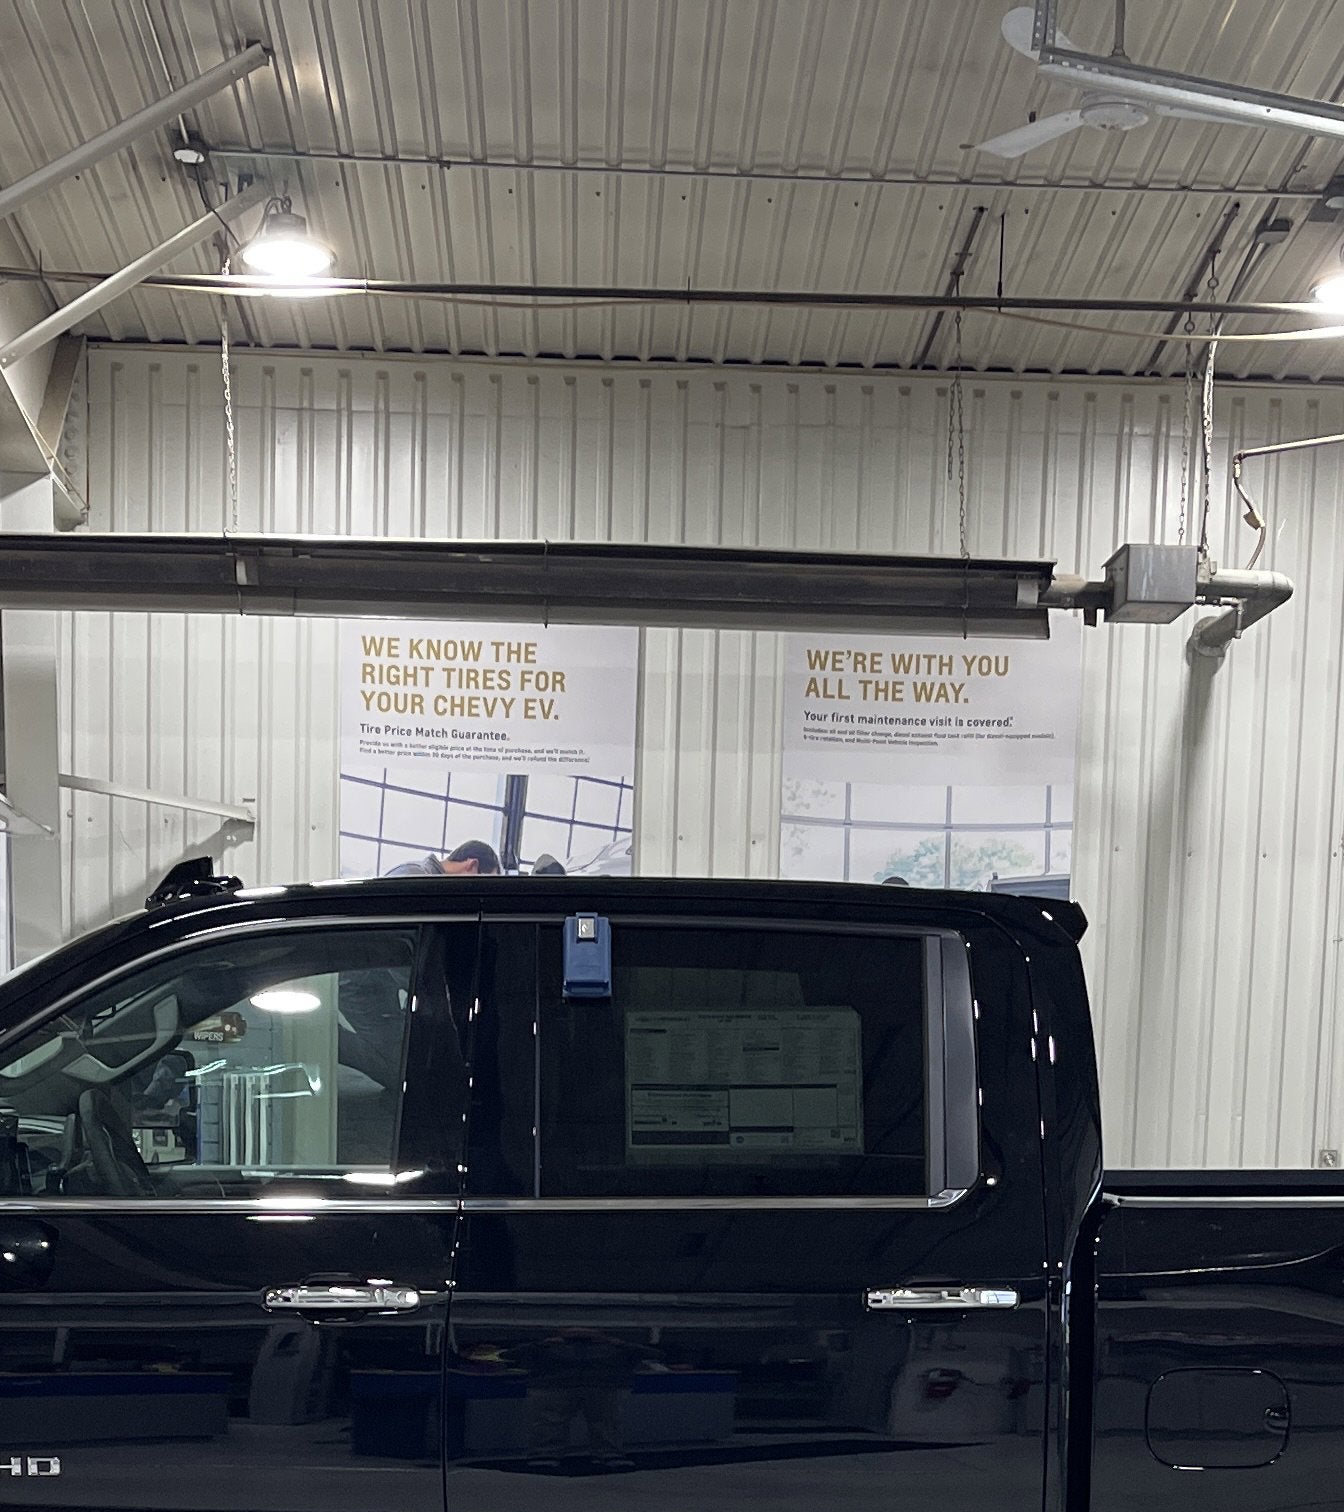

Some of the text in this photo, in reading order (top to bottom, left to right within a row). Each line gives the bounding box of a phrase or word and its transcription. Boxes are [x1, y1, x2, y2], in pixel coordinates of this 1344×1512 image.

[361, 636, 538, 664] WE KNOW THE
[807, 649, 1010, 677] WE'RE WITH YOU
[361, 663, 566, 693] RIGHT TIRES FOR
[805, 677, 970, 704] ALL THE WAY.
[360, 691, 559, 721] YOUR CHEVY EV.
[804, 710, 828, 722] Your
[832, 712, 855, 724] first
[858, 714, 927, 726] maintenance
[930, 716, 952, 727] visit
[955, 717, 964, 728] is
[360, 723, 510, 741] Tire Price Match Guarantee.
